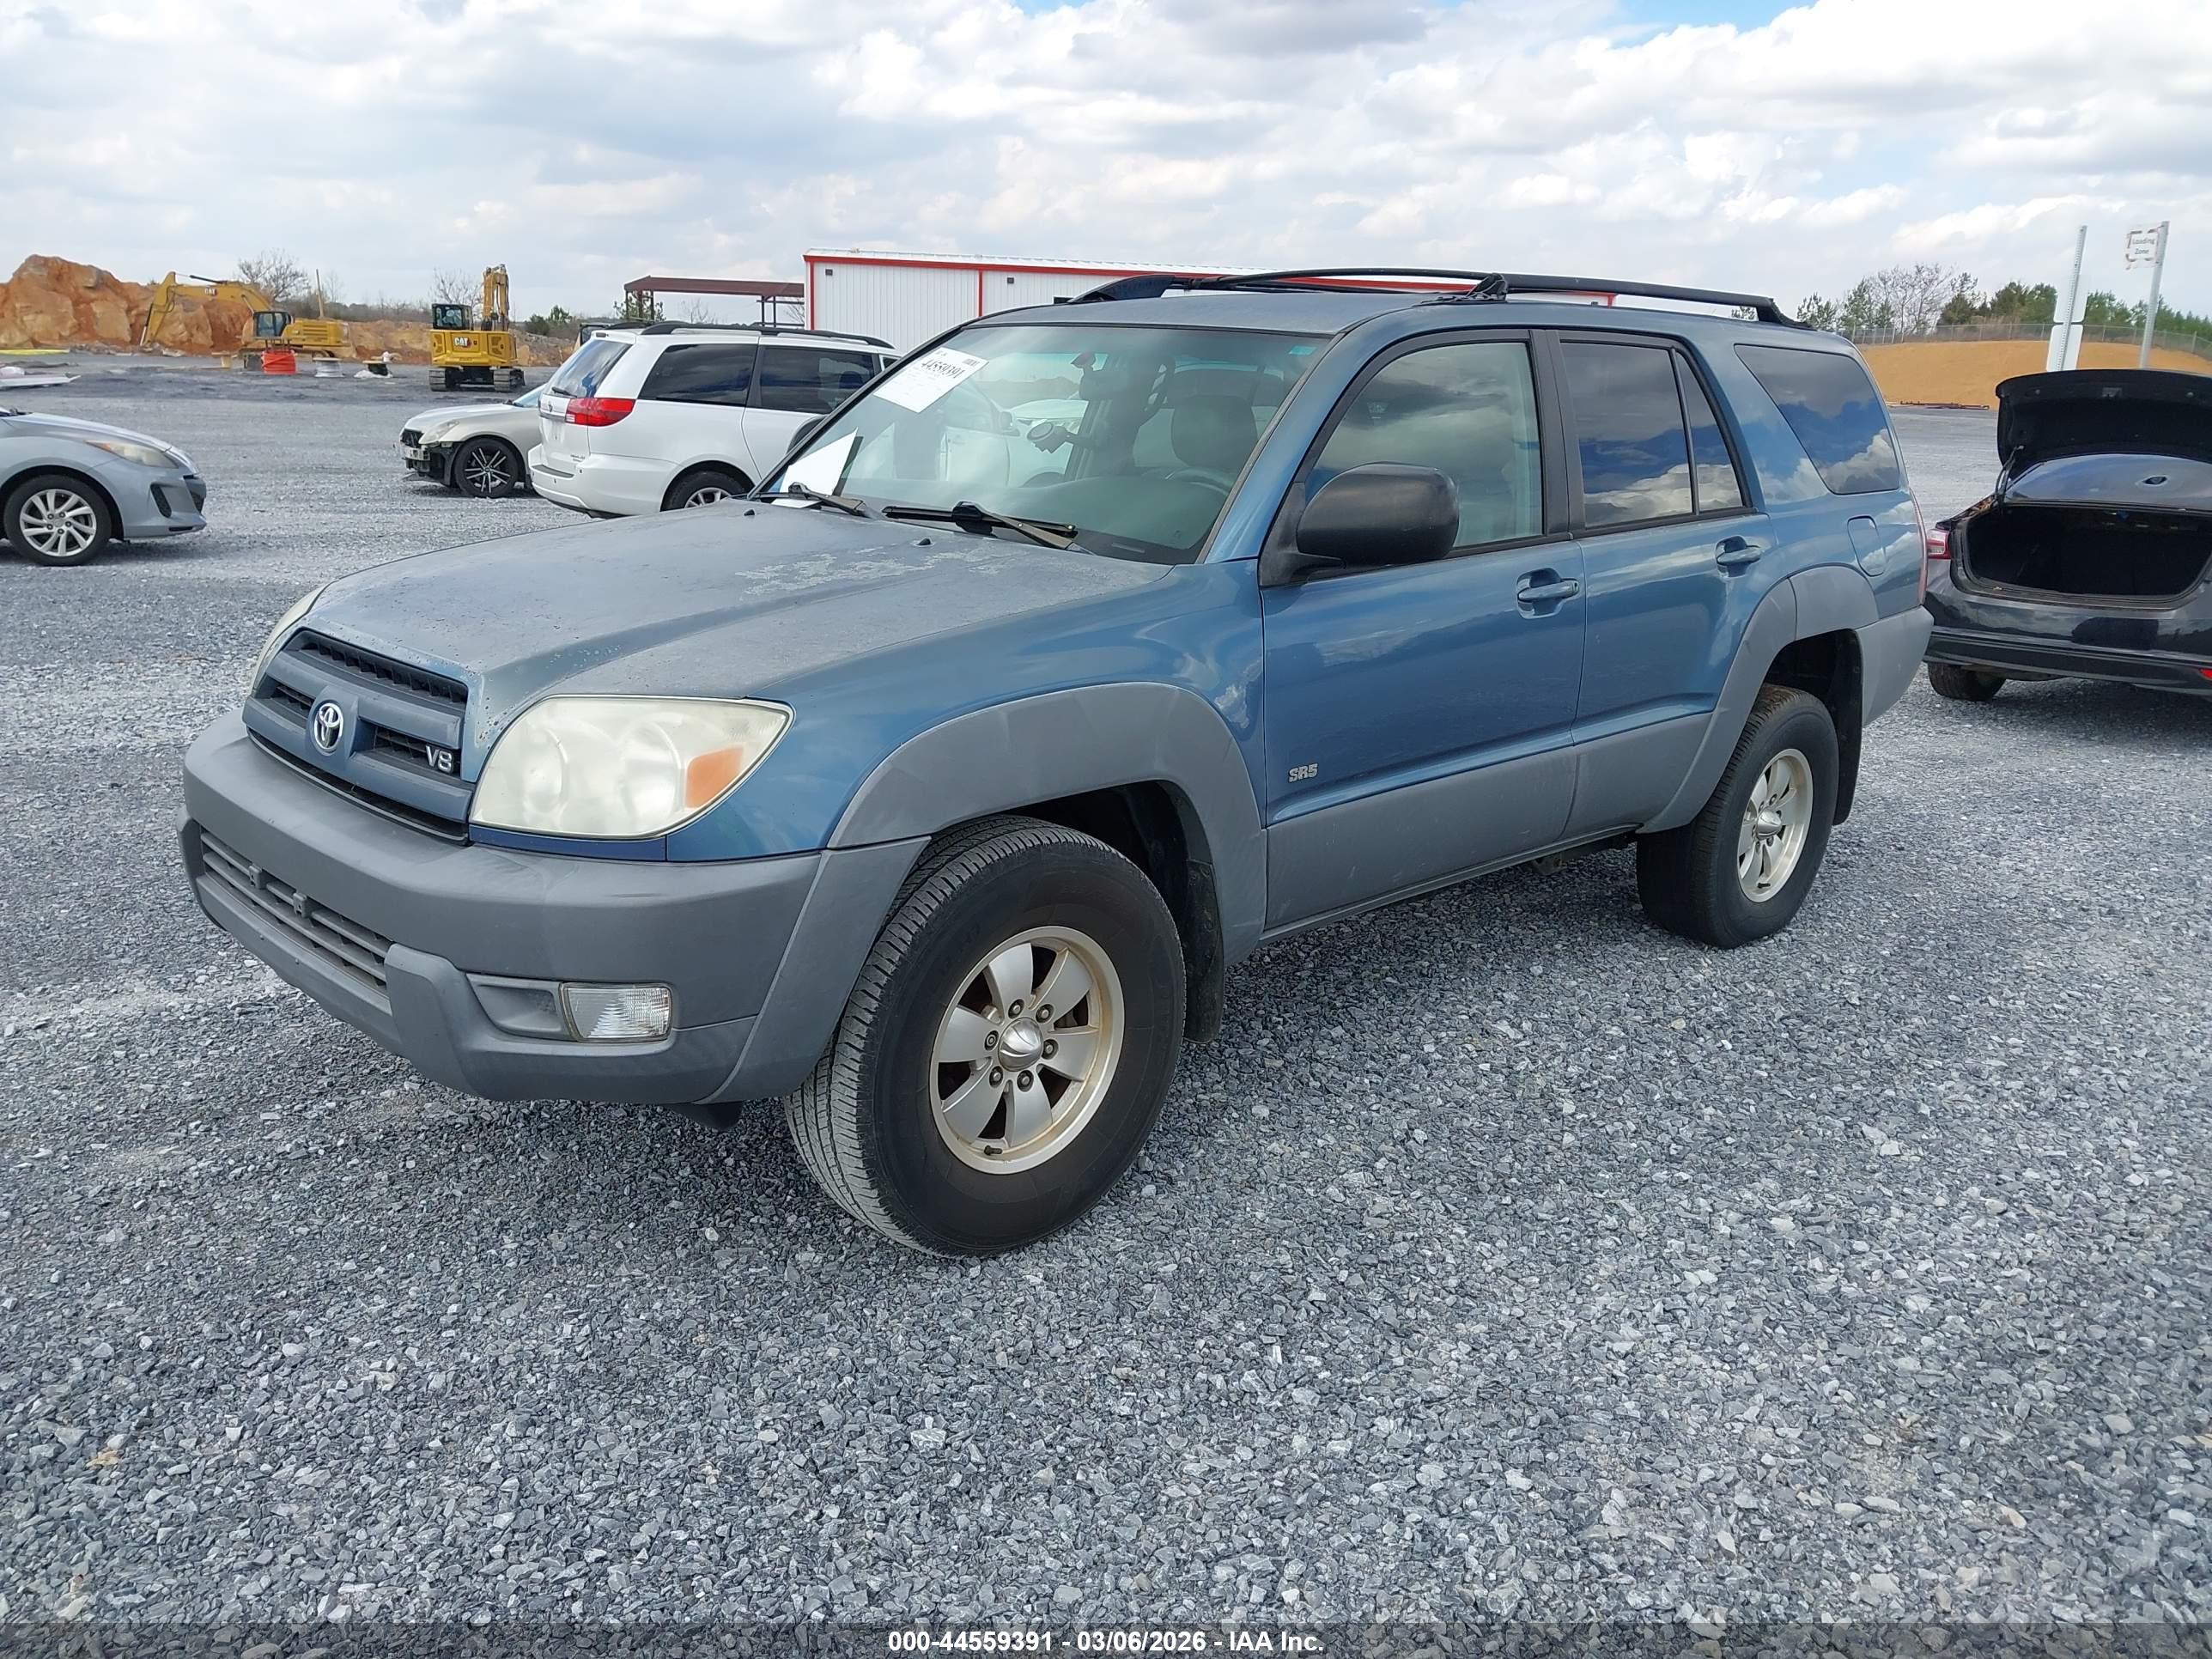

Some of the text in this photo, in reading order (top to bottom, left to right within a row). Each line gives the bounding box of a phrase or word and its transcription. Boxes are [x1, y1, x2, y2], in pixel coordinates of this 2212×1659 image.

[454, 337, 469, 347] CAT
[921, 358, 966, 379] 44559391
[425, 744, 453, 773] V8
[1288, 763, 1319, 783] SR5
